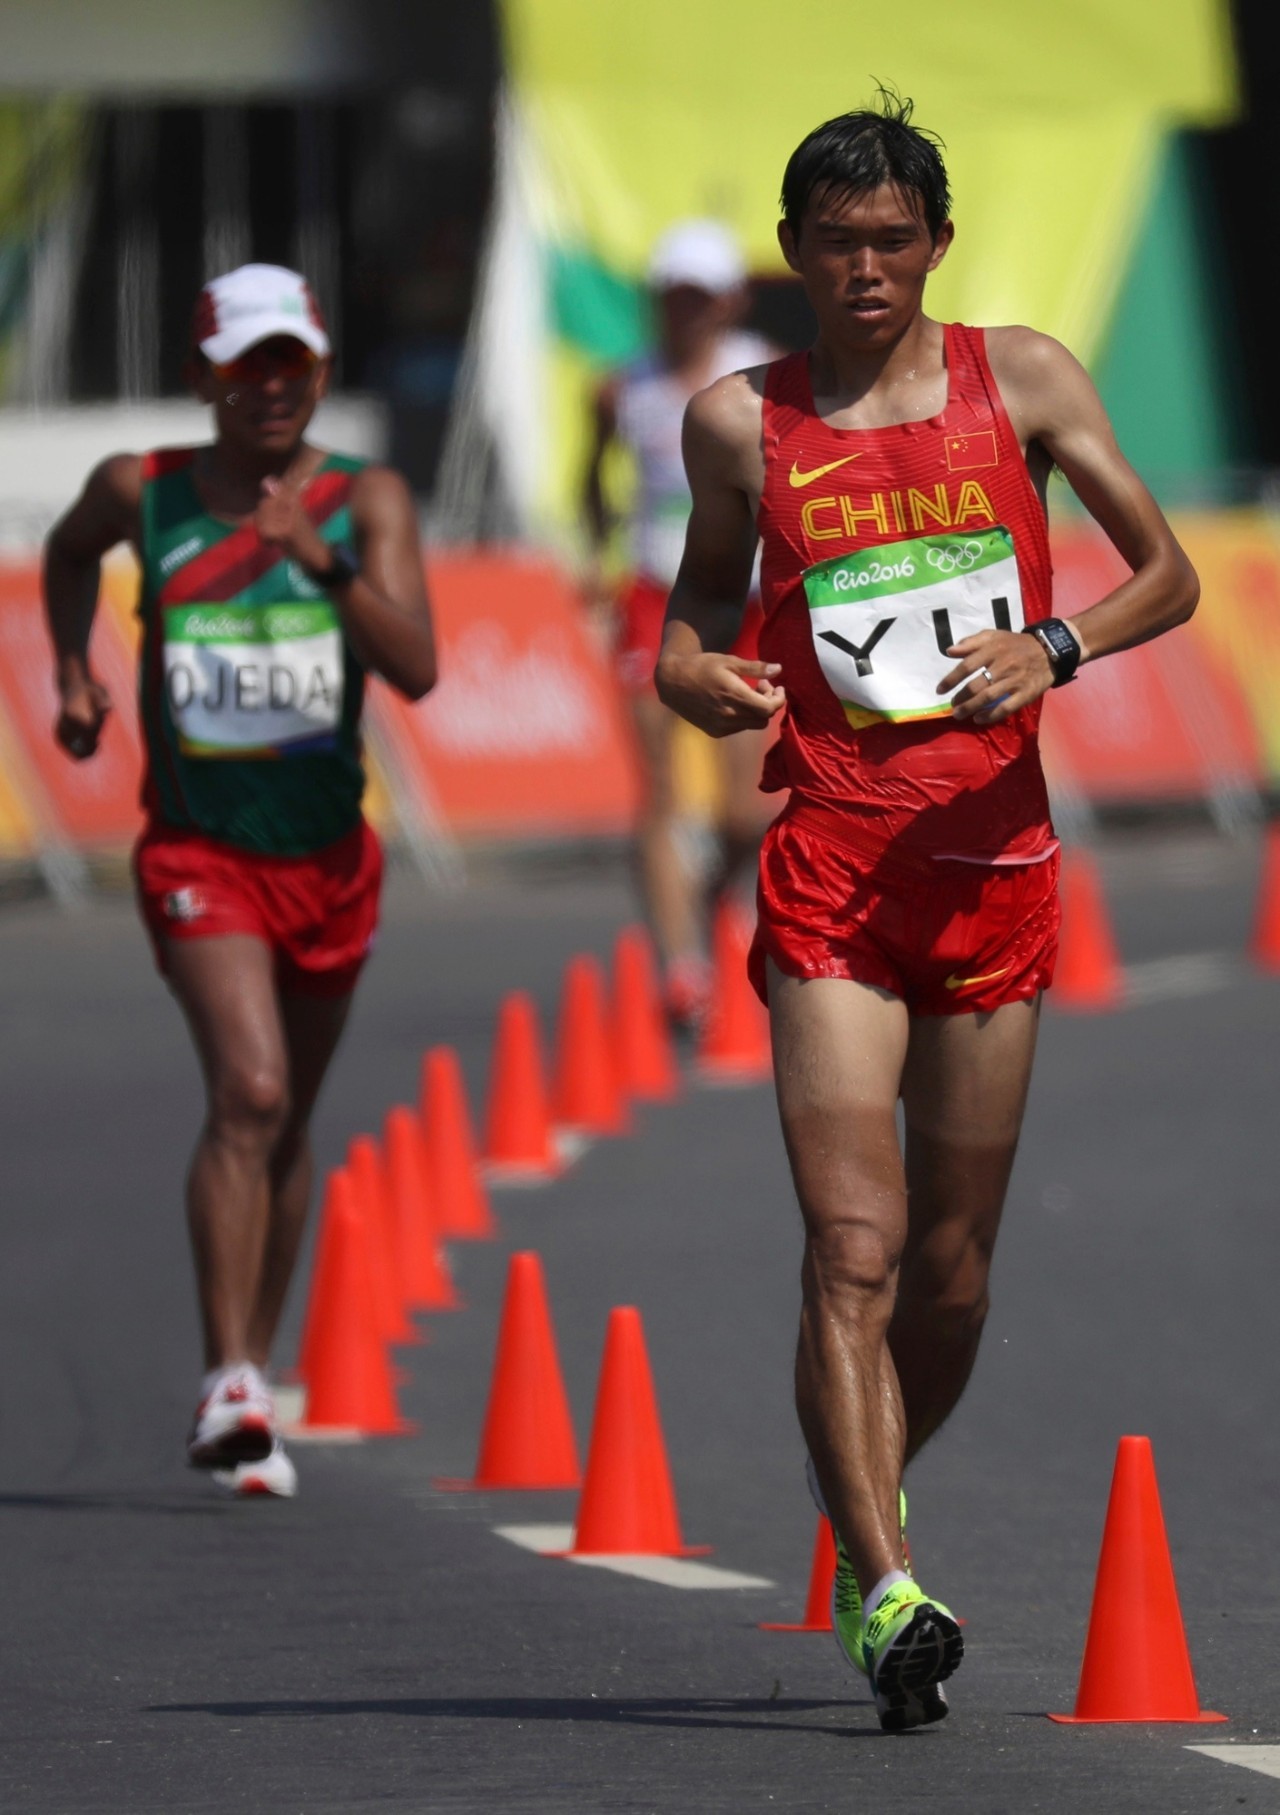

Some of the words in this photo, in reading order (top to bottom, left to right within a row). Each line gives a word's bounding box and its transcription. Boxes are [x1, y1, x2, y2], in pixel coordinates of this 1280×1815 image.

[801, 480, 997, 541] CHINA
[833, 556, 915, 592] Rio2016
[816, 596, 1012, 678] YU
[167, 663, 335, 713] OJEDA
